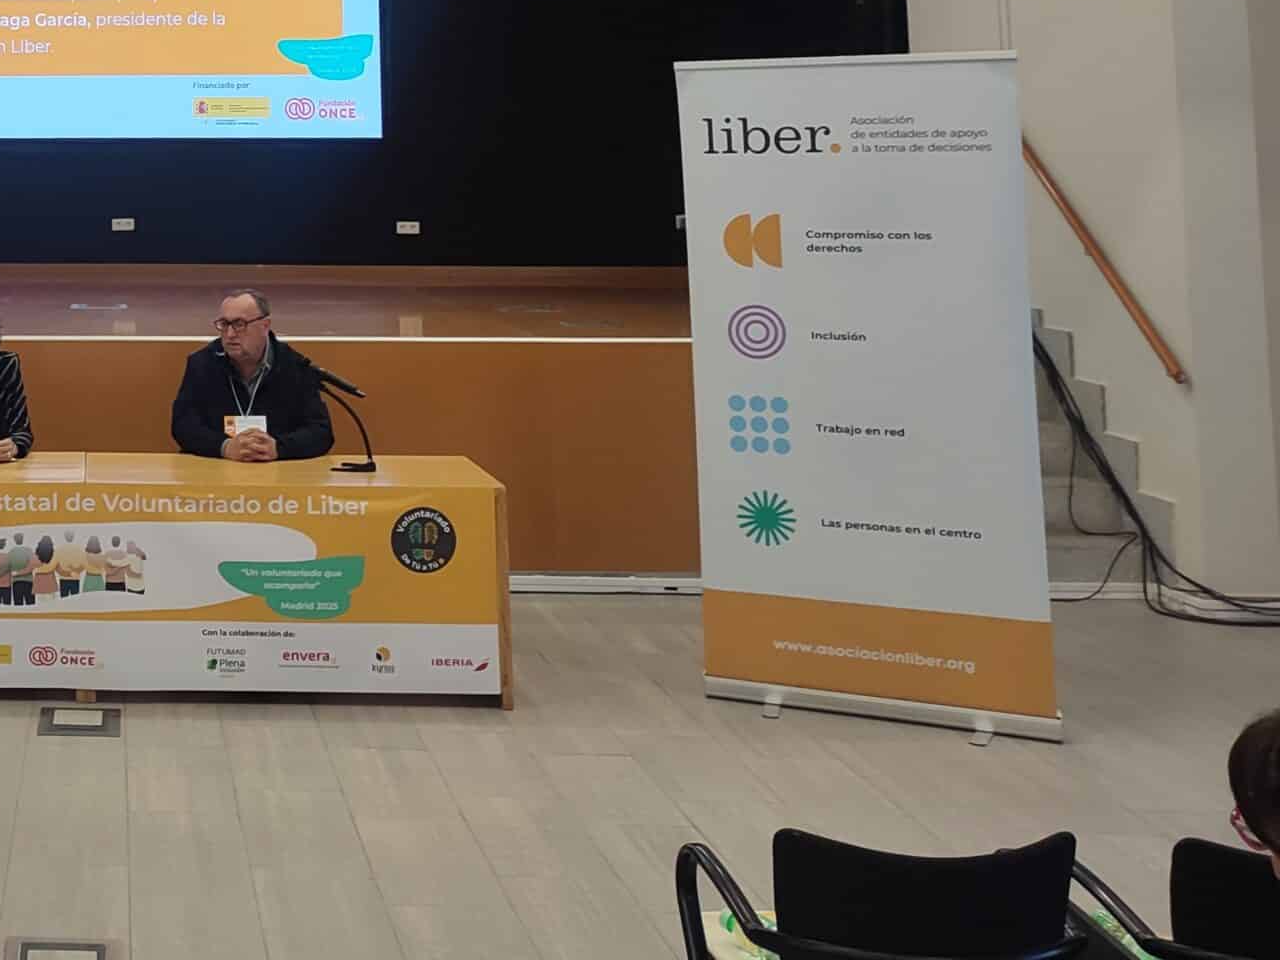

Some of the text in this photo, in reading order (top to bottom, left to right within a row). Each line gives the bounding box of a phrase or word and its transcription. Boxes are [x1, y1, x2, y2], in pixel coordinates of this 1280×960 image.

[35, 12, 91, 29] García,
[96, 11, 182, 29] presidente
[187, 11, 208, 26] de
[213, 11, 225, 26] la
[319, 108, 356, 119] ONCE
[850, 116, 914, 125] Asociación
[850, 129, 989, 139] de entidades de apoyo
[851, 143, 993, 153] a la toma de decisiones
[806, 230, 933, 240] Compromiso con los
[806, 243, 863, 253] derechos
[811, 331, 867, 341] Inclusión
[816, 423, 905, 437] Trabajo en red
[65, 493, 96, 512] de
[102, 493, 261, 514] Voluntariado
[268, 495, 298, 514] de
[307, 495, 368, 515] Liber
[396, 510, 451, 533] Voluntariado
[821, 518, 982, 540] Las personas en el centro
[281, 601, 314, 610] Madrid
[201, 628, 218, 637] Con
[219, 628, 227, 637] la
[228, 628, 282, 638] colaboración
[282, 649, 330, 662] envera
[773, 639, 976, 674] www.asociacionliber.org
[60, 656, 95, 666] ONCE
[219, 658, 246, 668] Plena
[431, 658, 473, 667] IBERIA
